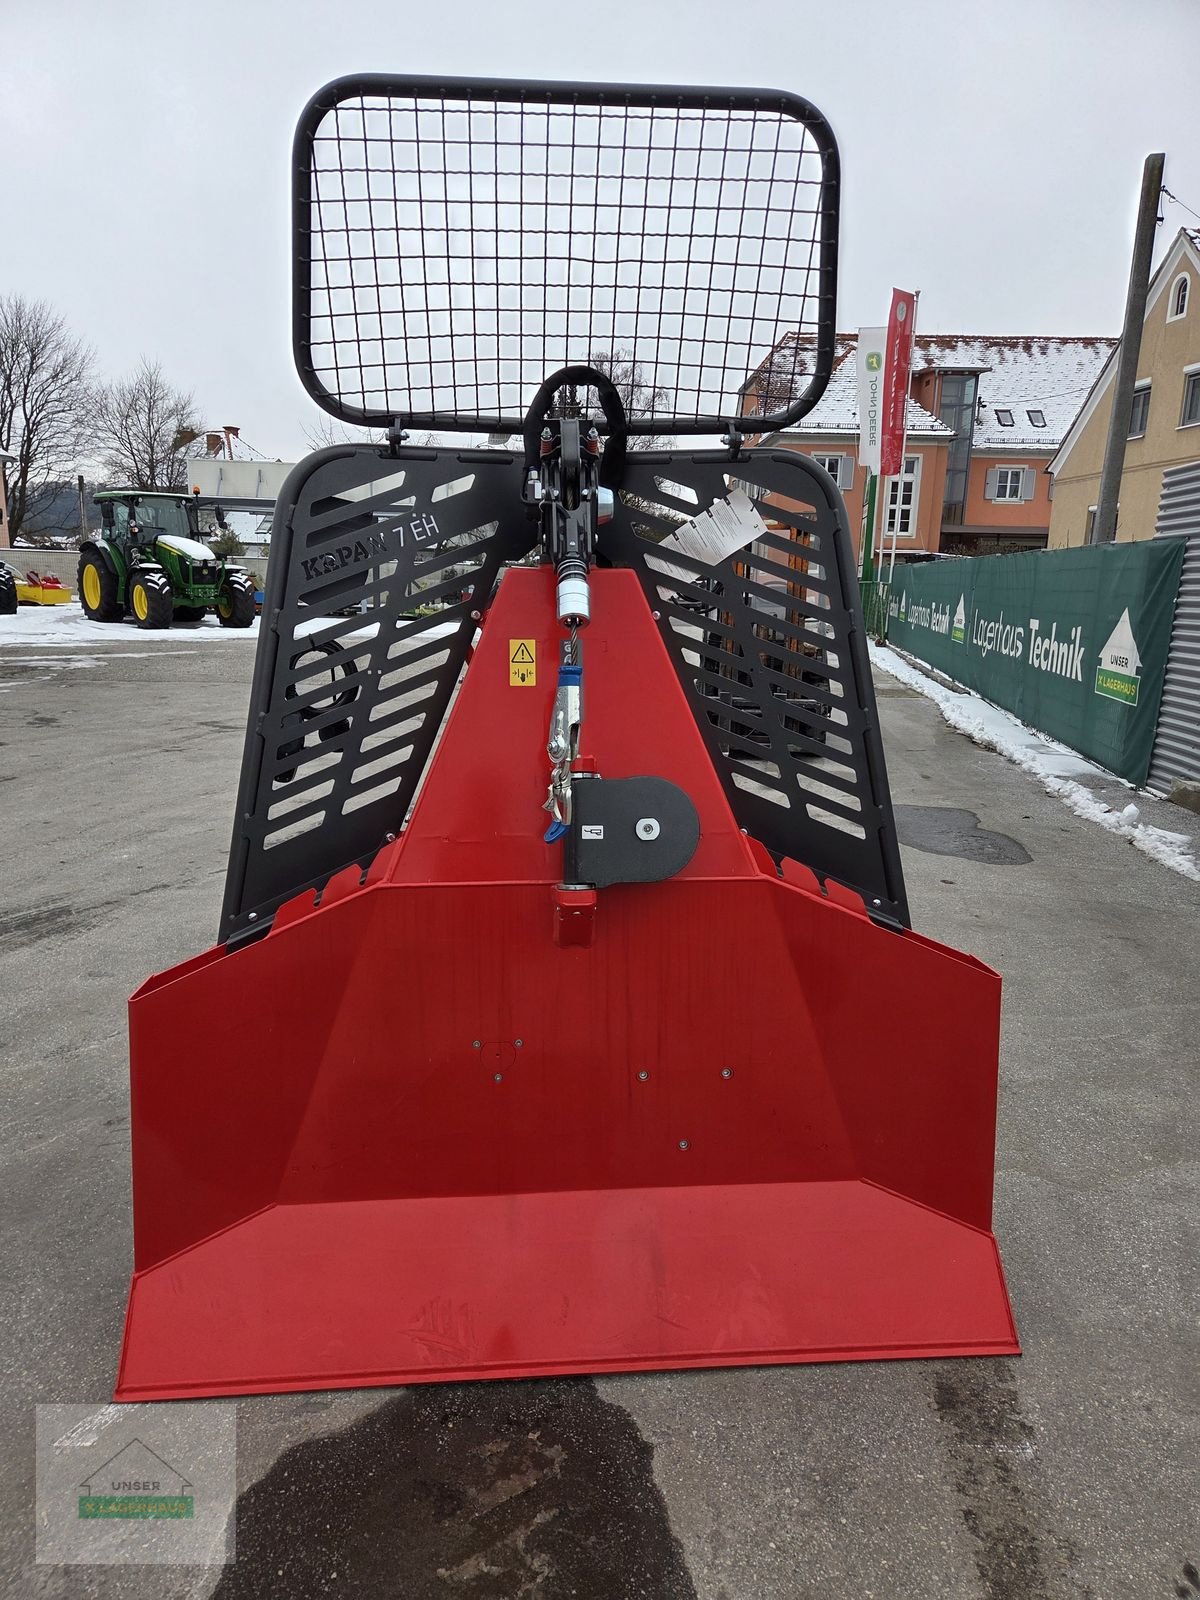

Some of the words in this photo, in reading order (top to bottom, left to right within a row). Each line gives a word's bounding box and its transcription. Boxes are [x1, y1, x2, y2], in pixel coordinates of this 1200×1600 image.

[392, 526, 404, 547] 7
[972, 608, 1024, 658] Lagerhaus
[1029, 618, 1085, 682] Technik
[1110, 654, 1129, 668] UNSER
[1103, 676, 1136, 696] LAGERHAUS
